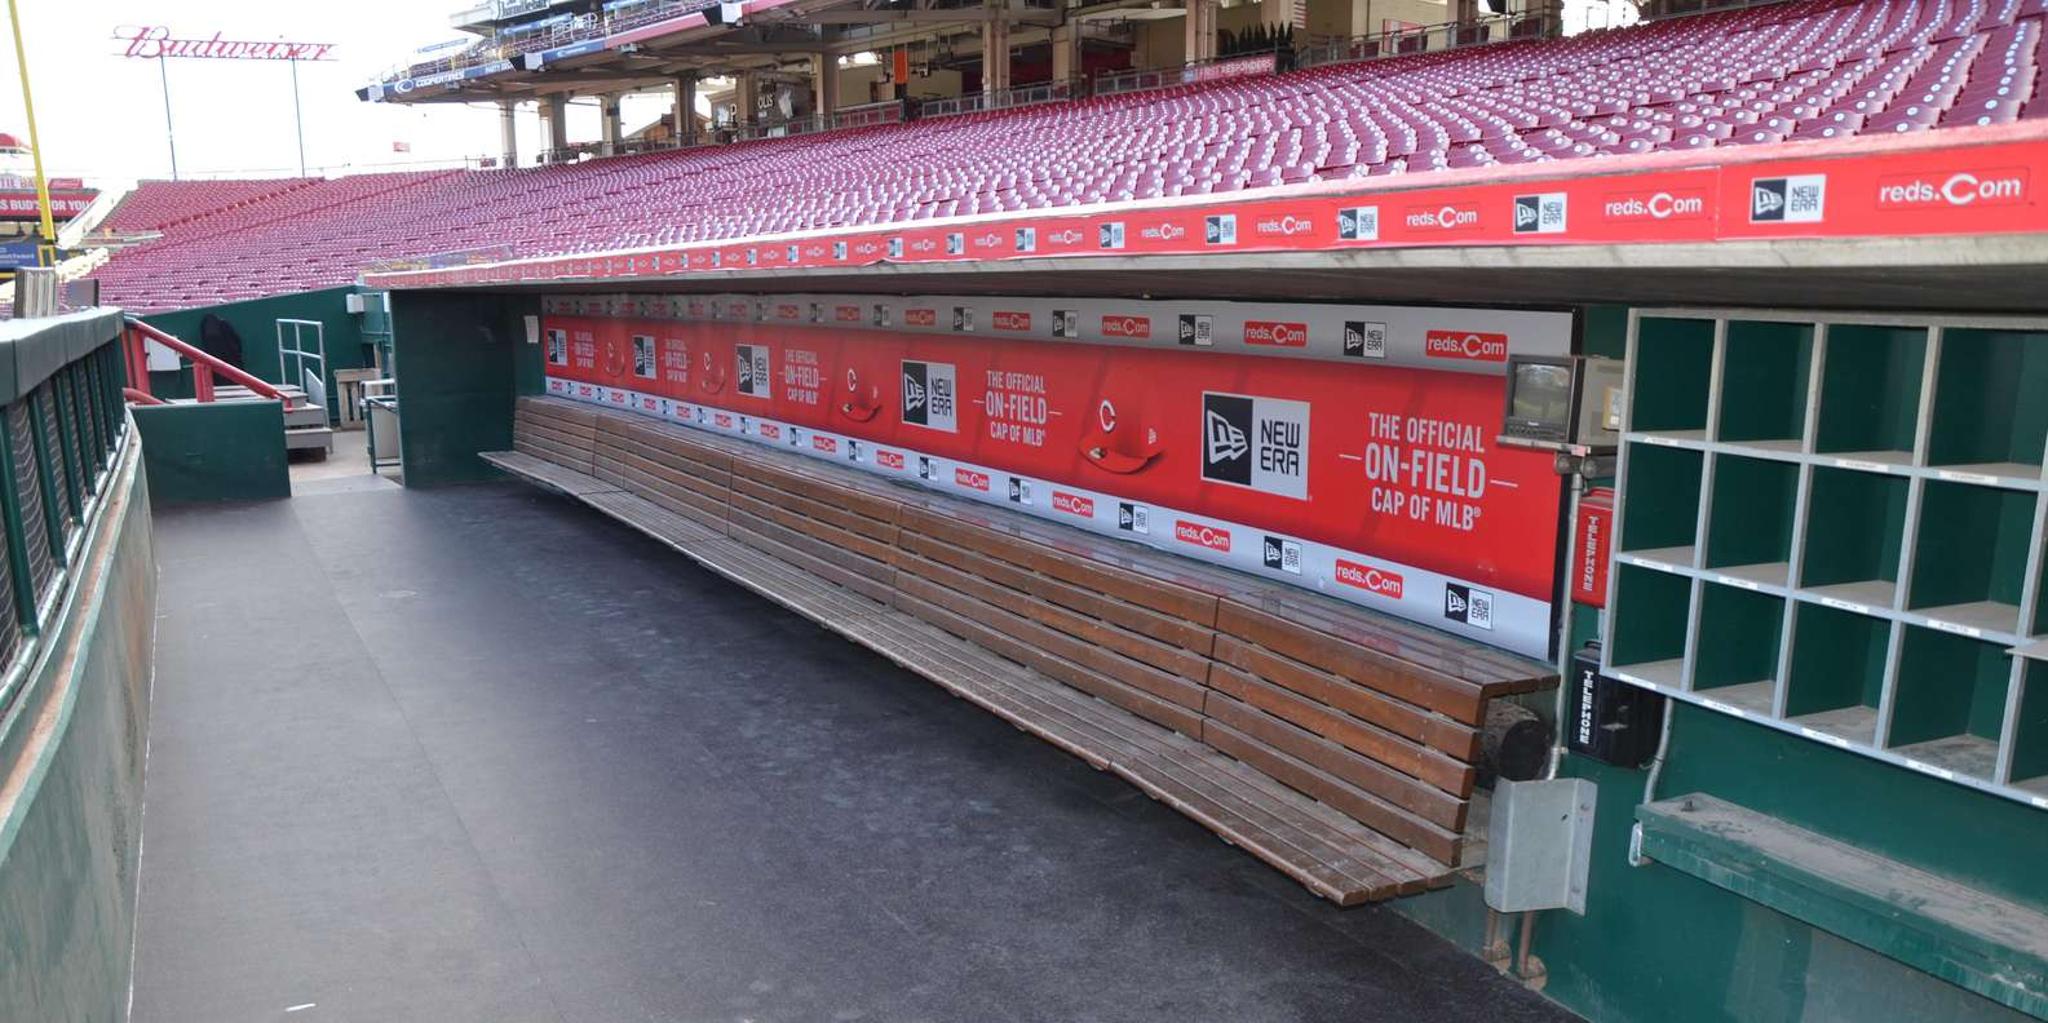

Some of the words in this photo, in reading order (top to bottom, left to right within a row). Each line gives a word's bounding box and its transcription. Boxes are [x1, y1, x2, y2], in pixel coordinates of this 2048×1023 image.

[113, 26, 333, 60] Budweiser
[1791, 185, 1820, 198] NEW
[1879, 173, 2022, 205] reds.Com
[1605, 192, 1702, 219] reds.Com
[1791, 199, 1818, 212] ERA
[931, 377, 952, 398] NEW
[986, 370, 1004, 389] THE
[1006, 372, 1046, 394] OFFICIAL
[931, 396, 952, 417] ERA
[985, 390, 1047, 425] ON-FIELD
[990, 421, 1008, 440] CAP
[1010, 424, 1021, 443] OF
[1261, 418, 1300, 449] NEW
[1369, 412, 1400, 440] THE
[1407, 417, 1486, 453] OFFICIAL
[1260, 446, 1300, 477] ERA
[1365, 442, 1486, 499] ON-FIELD
[1372, 487, 1404, 516] CAP
[1410, 494, 1431, 522] OF
[1579, 670, 1595, 745] TELEPHONE
